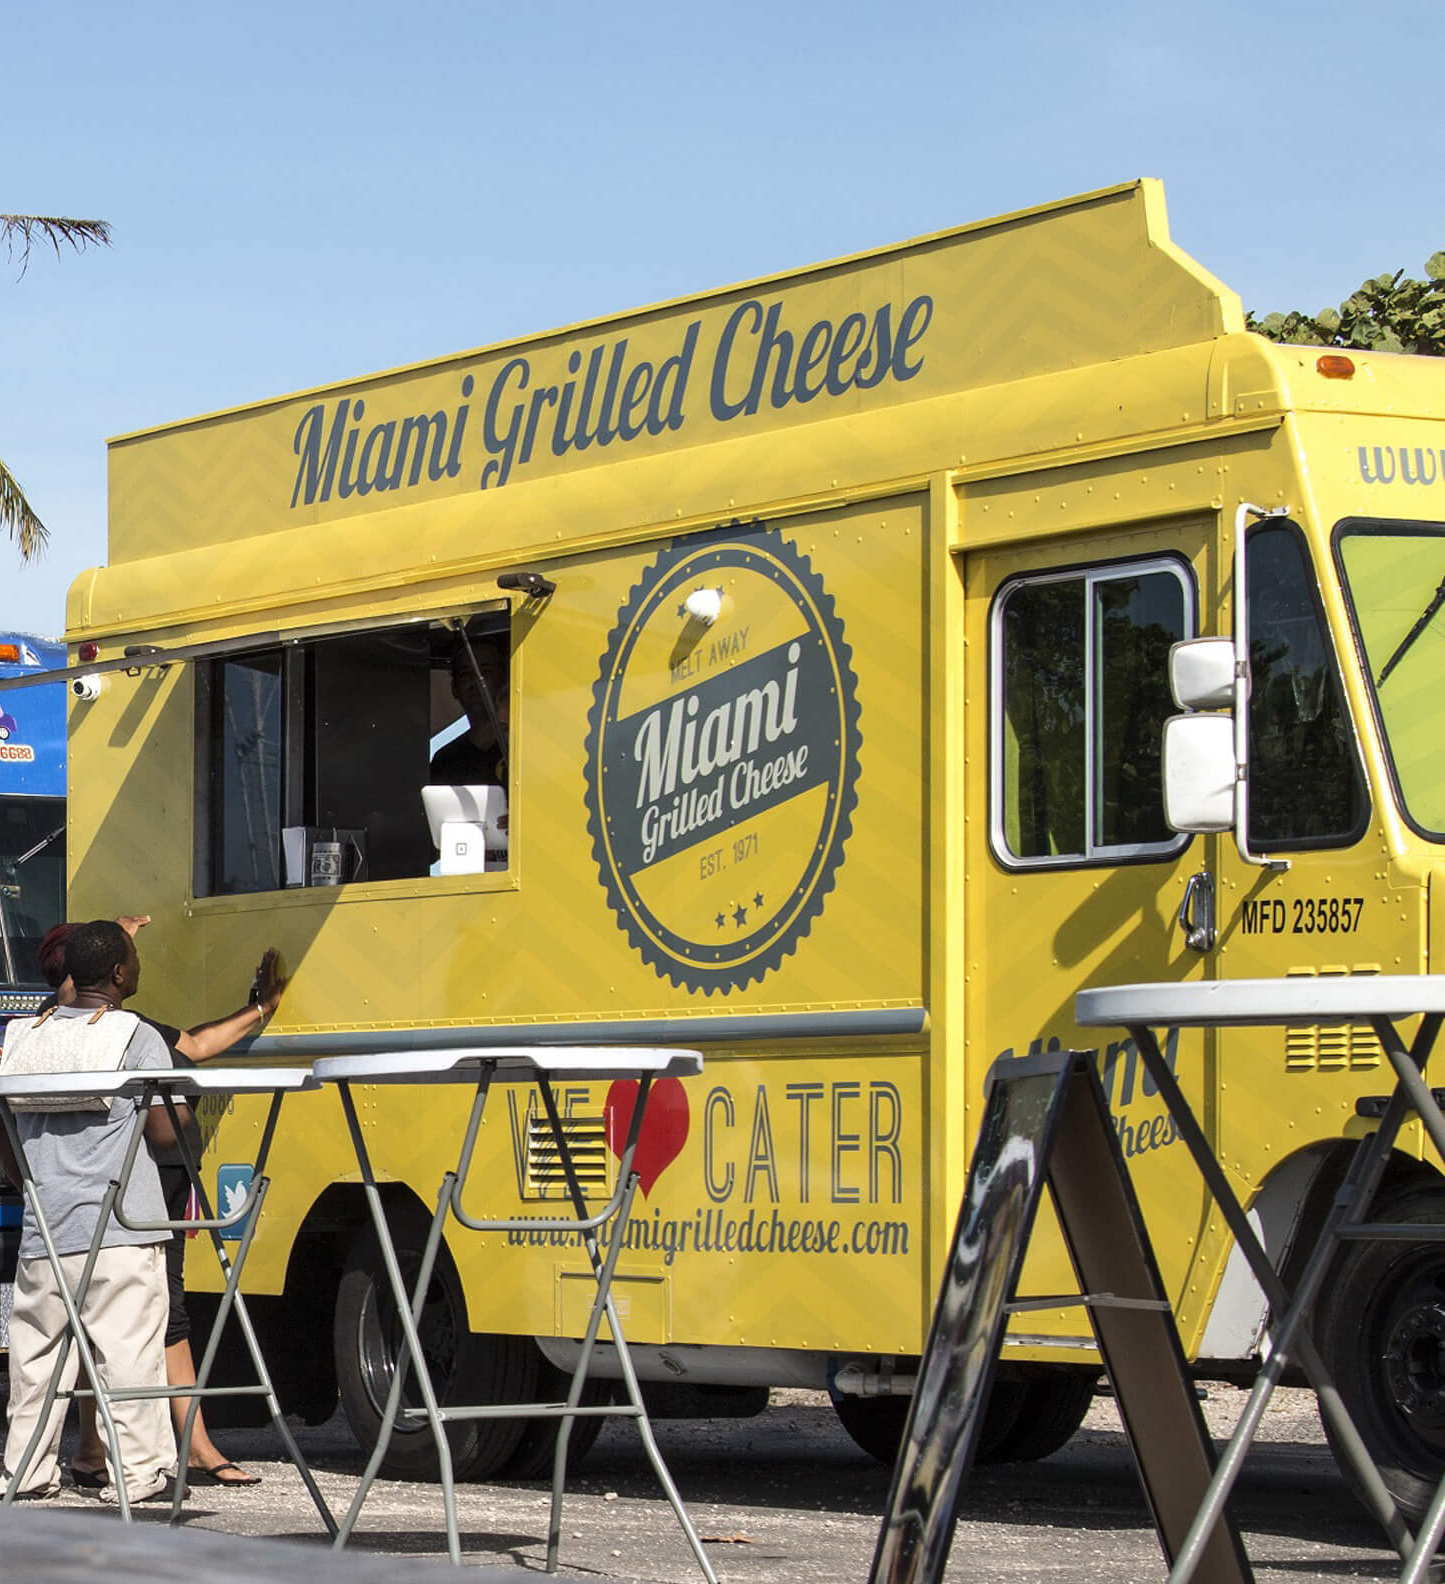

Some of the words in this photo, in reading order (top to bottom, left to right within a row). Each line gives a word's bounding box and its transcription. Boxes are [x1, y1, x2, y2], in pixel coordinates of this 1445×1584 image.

[290, 374, 474, 509] Miami
[481, 319, 702, 490] Grilled
[709, 295, 934, 422] Cheese
[1358, 446, 1445, 486] ww
[670, 649, 704, 684] MELT
[708, 628, 751, 665] AWAY
[634, 642, 801, 809] Miami
[642, 776, 726, 864] Grilled
[730, 744, 809, 811] Cheese
[700, 848, 727, 881] EST.
[733, 831, 759, 864] 1971
[1241, 900, 1286, 935] MFD
[1292, 897, 1365, 934] 235857
[704, 1081, 903, 1204] CATER
